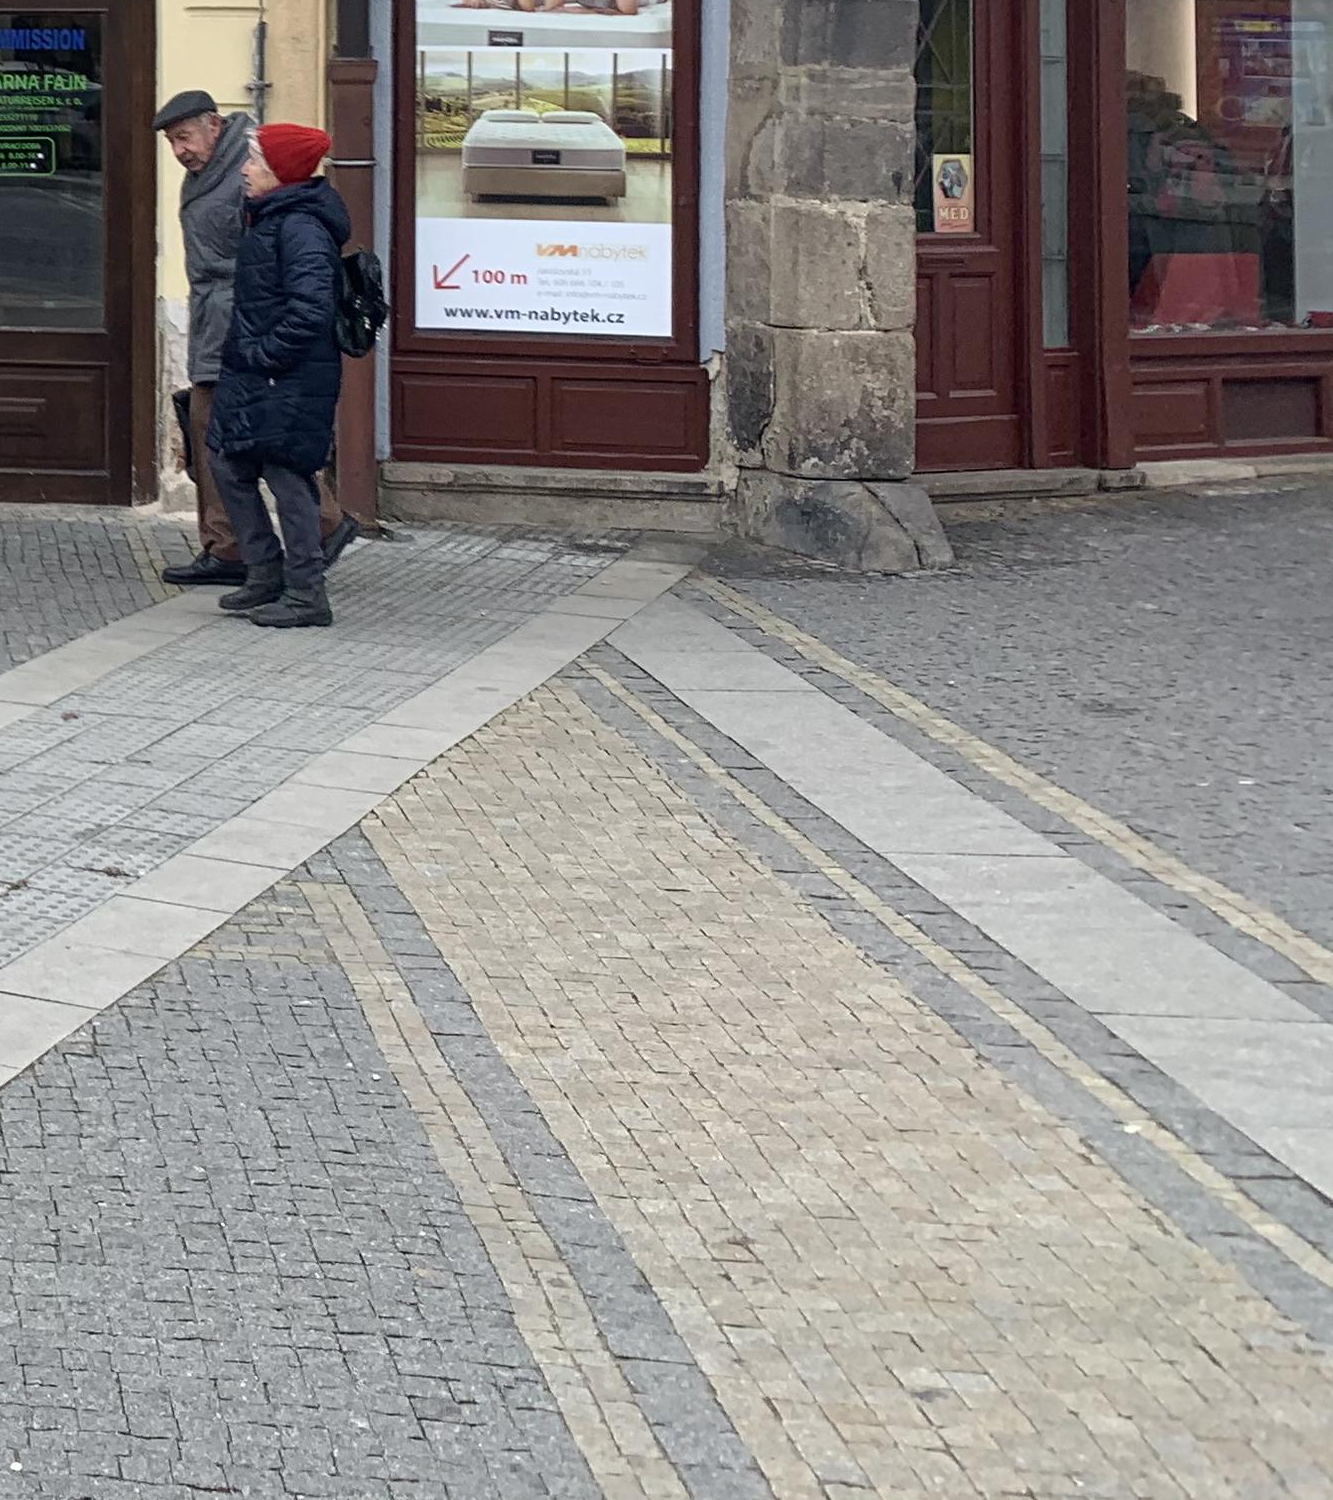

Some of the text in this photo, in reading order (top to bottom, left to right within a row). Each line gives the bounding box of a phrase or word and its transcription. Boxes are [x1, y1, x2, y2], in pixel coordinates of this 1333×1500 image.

[44, 74, 87, 91] FAJN
[938, 207, 969, 220] MED
[472, 269, 505, 284] 100
[510, 272, 528, 285] m
[444, 305, 625, 326] www.vm-nabytek.cz
